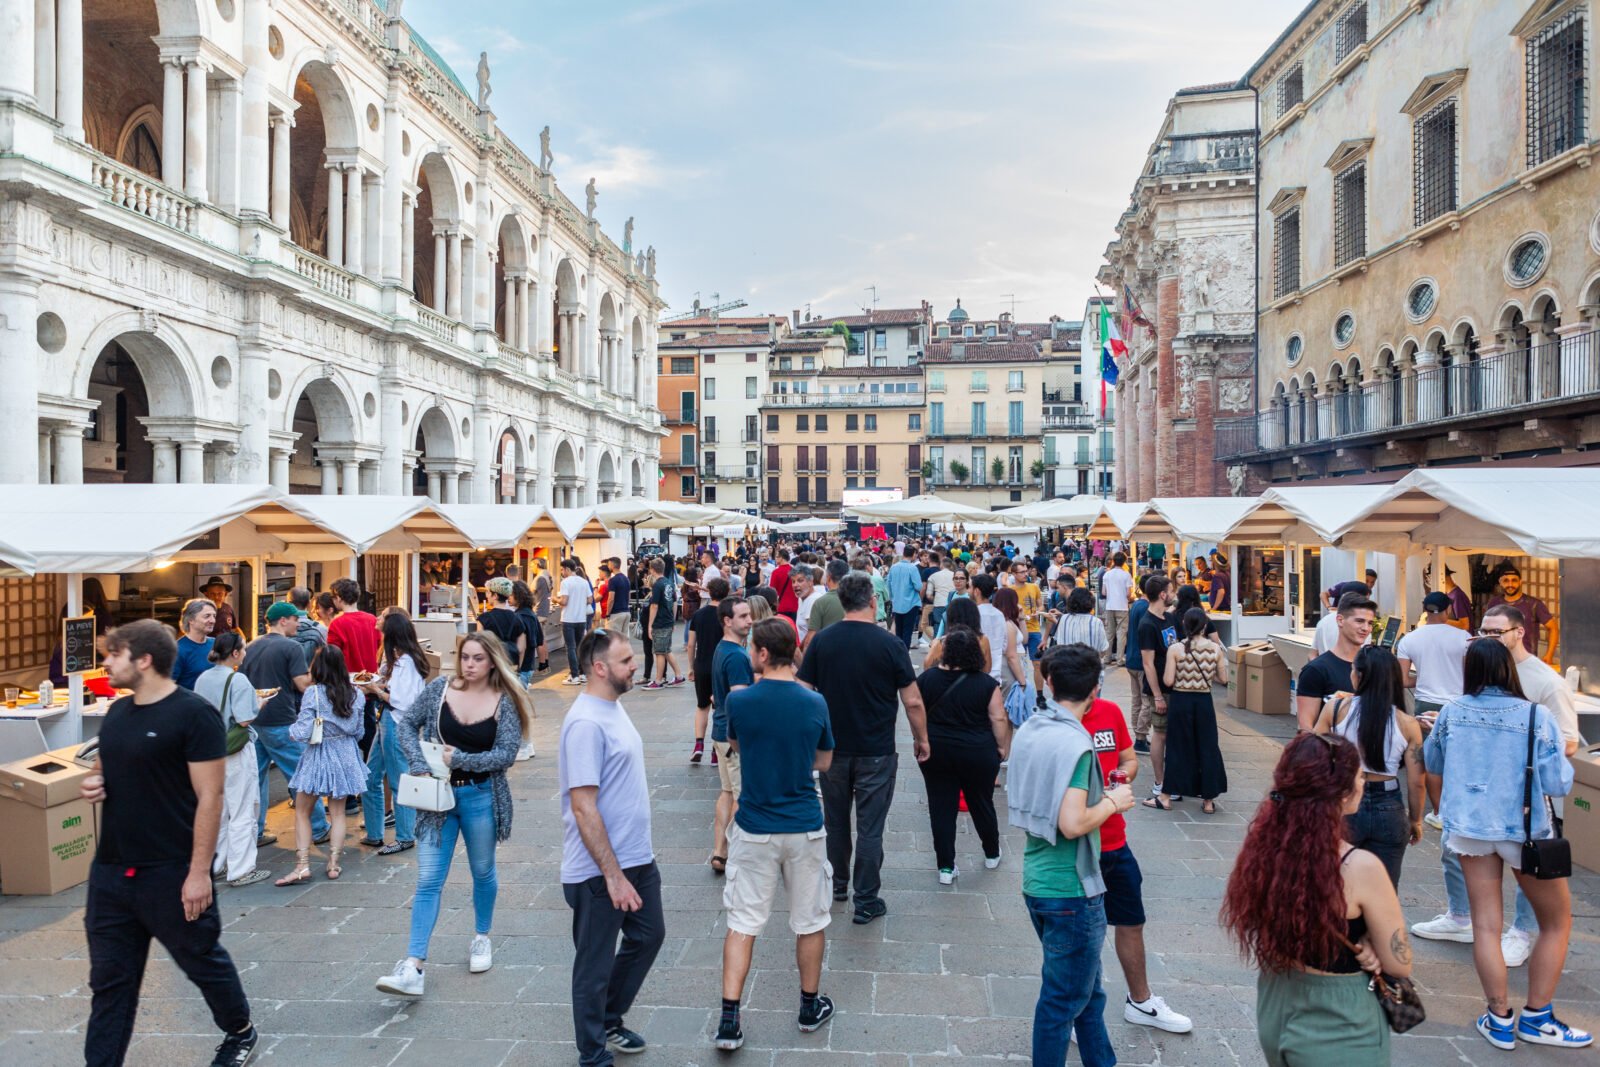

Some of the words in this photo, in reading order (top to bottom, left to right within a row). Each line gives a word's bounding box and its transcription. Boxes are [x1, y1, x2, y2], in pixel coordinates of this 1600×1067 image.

[1094, 731, 1116, 748] ESEL
[62, 816, 81, 829] aim
[57, 842, 84, 856] PLASTICA
[61, 848, 86, 860] METALLO
